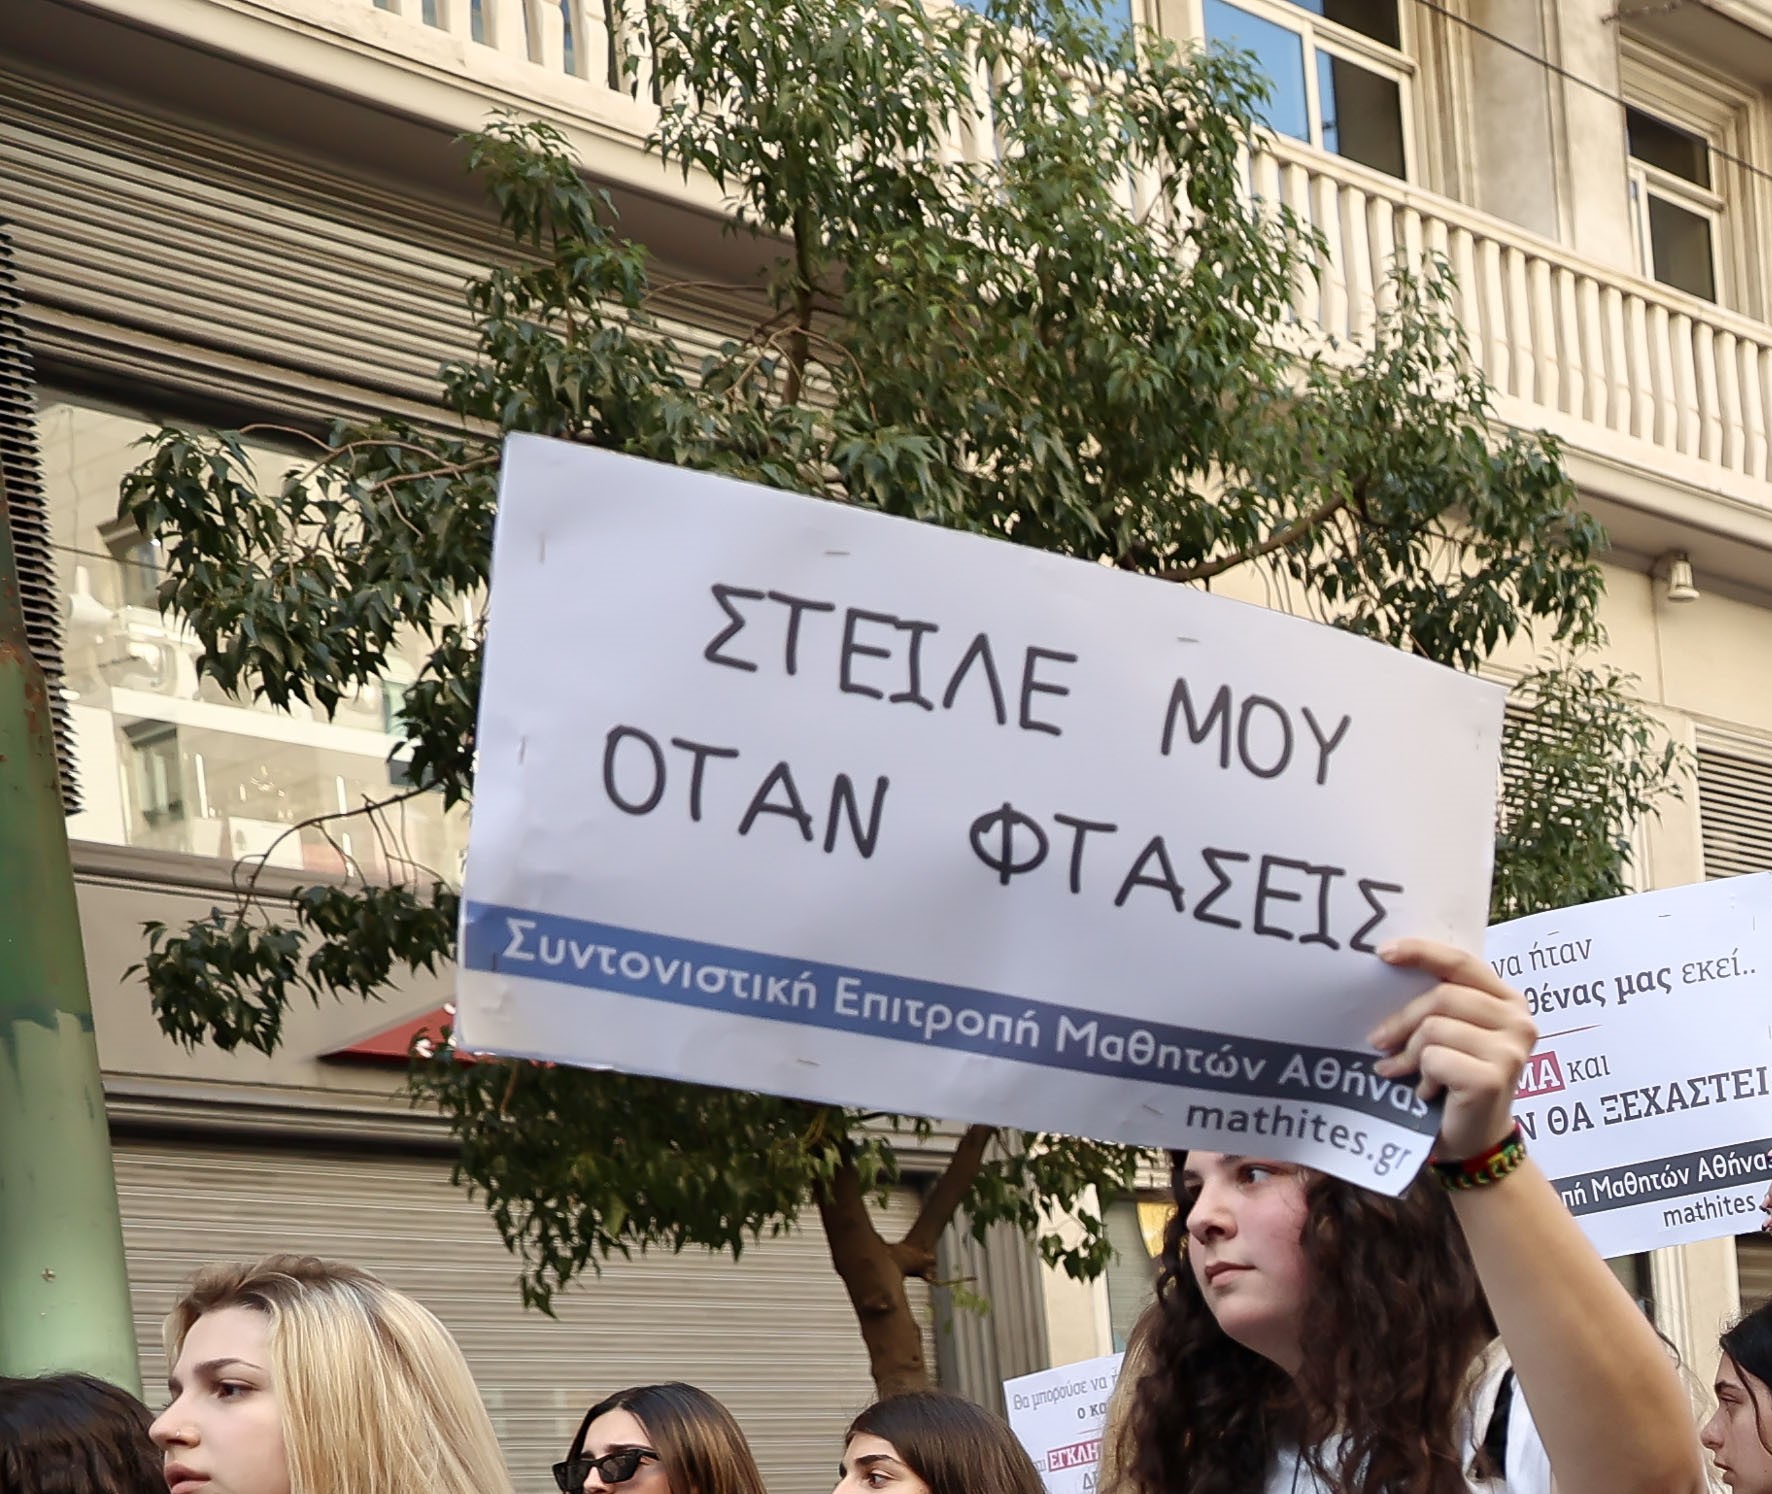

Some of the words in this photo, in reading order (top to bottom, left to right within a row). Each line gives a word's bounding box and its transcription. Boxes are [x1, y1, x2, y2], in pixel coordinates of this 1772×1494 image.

[704, 582, 1078, 737] ΣΤΕΙΛΕ
[1161, 678, 1351, 788] ΜΟΥ
[603, 723, 890, 860] ΟΤΑΝ
[970, 801, 1404, 954] ΦΤΑΣΕΙΣ
[1528, 939, 1592, 971] ήταν
[501, 917, 817, 1010] Συντονιστική
[834, 976, 1040, 1048] Επιτροπή
[1056, 1016, 1267, 1081] Μαθητών
[1524, 982, 1606, 1016] θένας
[1614, 967, 1672, 1005] μας
[1567, 1055, 1611, 1083] και
[1186, 1103, 1412, 1176] mathites.gr
[1547, 1101, 1595, 1135] ΘΑ
[1591, 1164, 1690, 1202] Μαθητών
[1663, 1194, 1756, 1228] mathites
